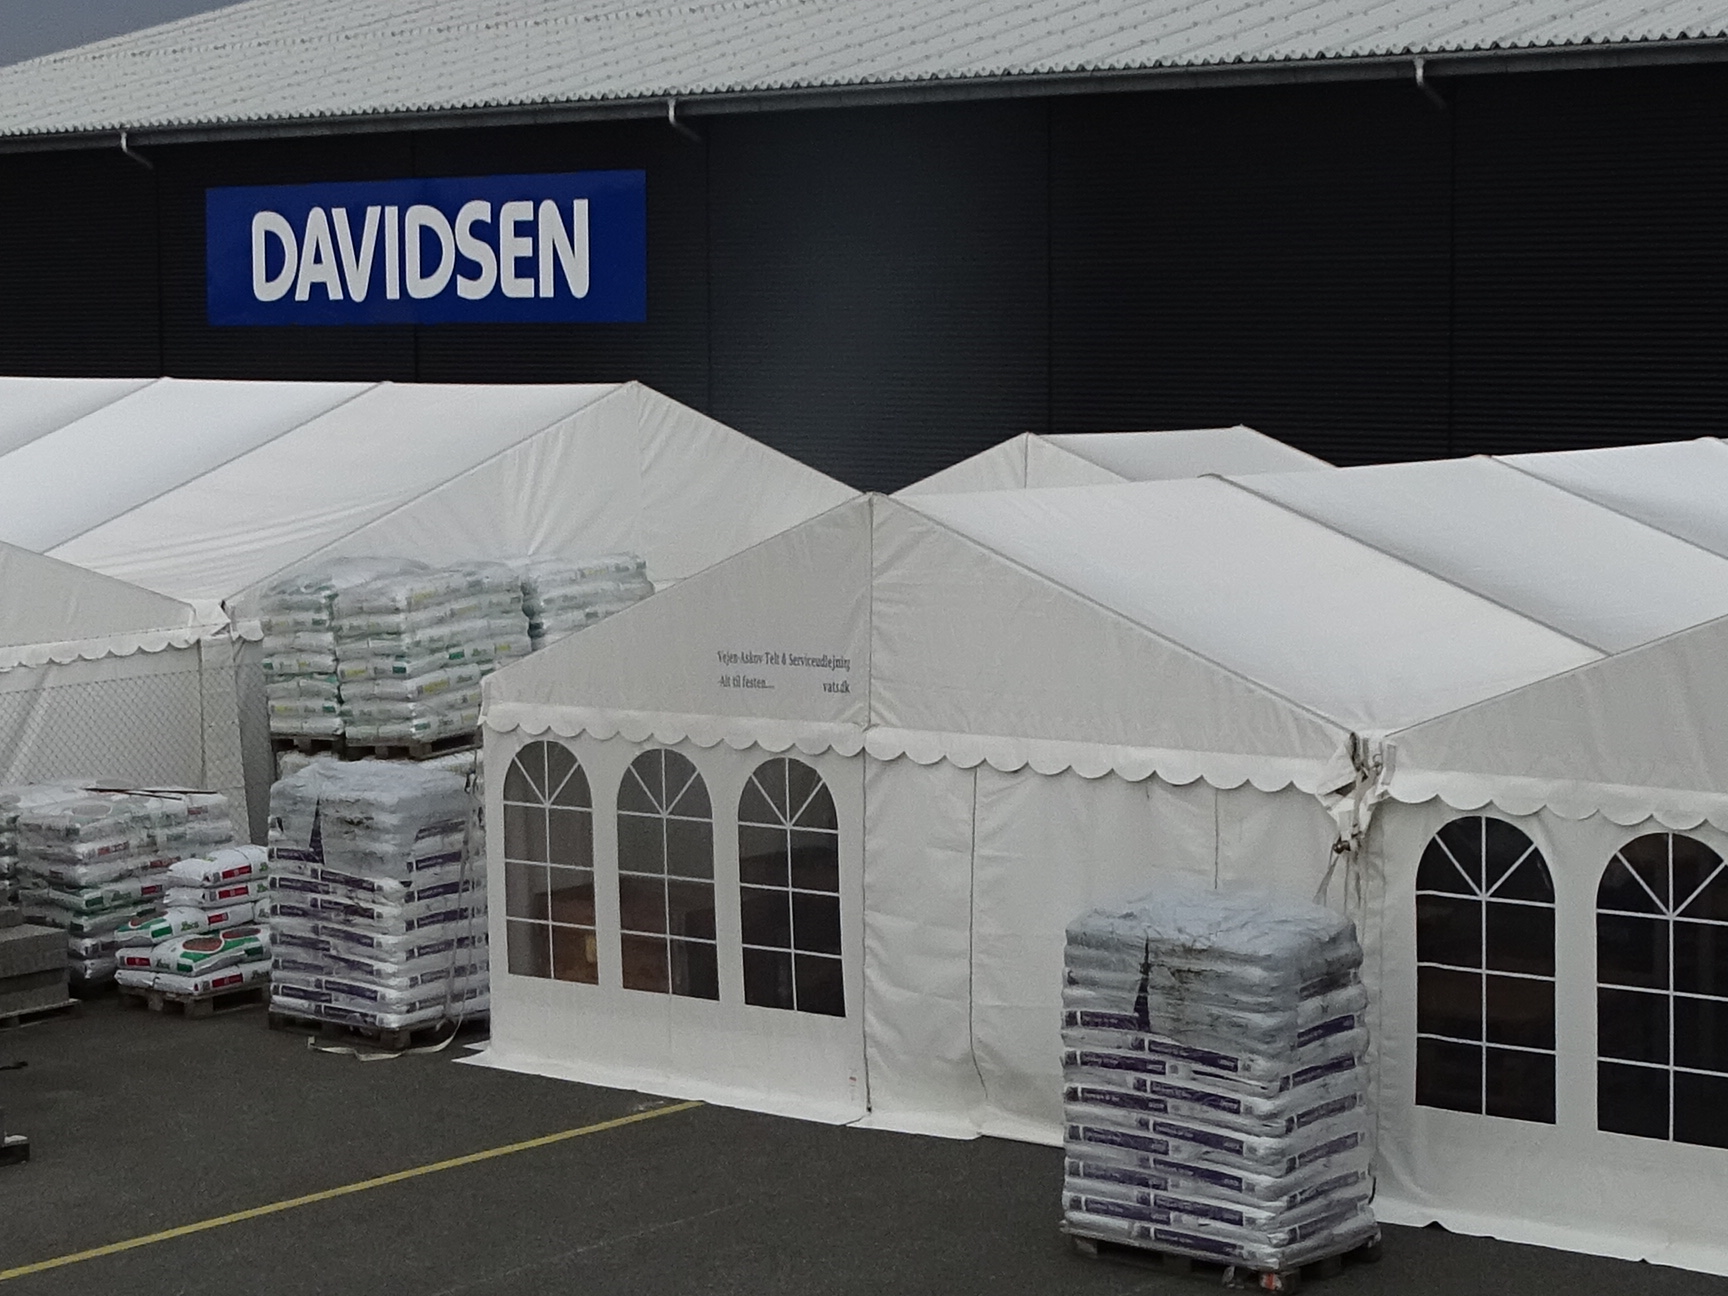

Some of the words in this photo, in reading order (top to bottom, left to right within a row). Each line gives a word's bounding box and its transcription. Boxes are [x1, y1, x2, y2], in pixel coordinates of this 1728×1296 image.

[251, 199, 589, 302] DAVIDSEN
[765, 652, 780, 665] Telt
[822, 680, 851, 694] vats.dk
